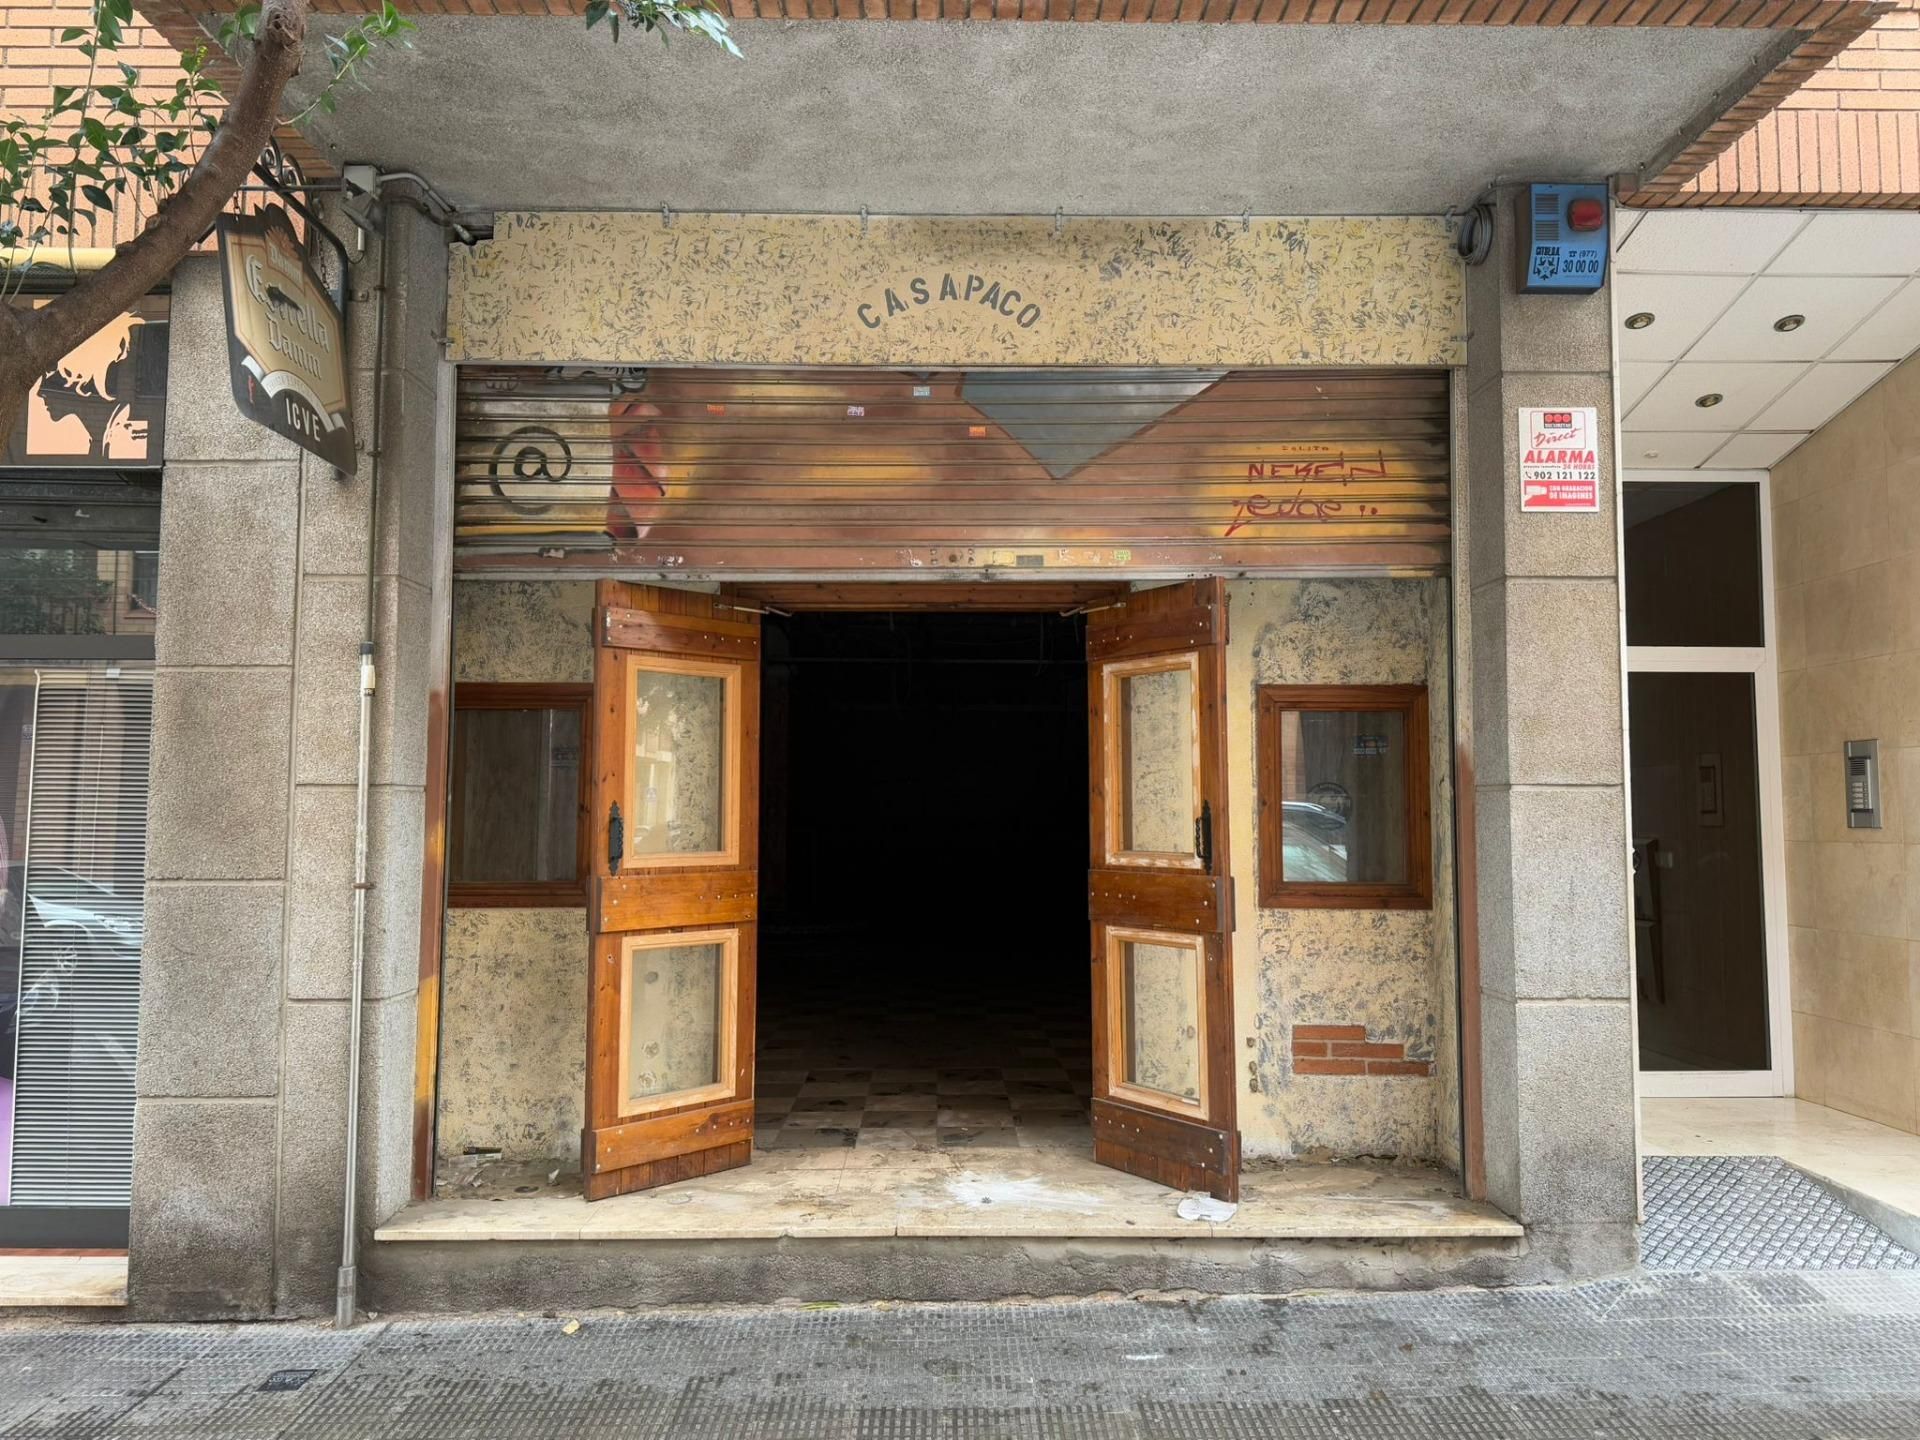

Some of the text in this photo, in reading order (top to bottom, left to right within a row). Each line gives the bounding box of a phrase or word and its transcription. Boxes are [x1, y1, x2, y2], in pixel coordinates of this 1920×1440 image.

[1579, 249, 1598, 258] (977)
[1562, 260, 1599, 273] 30 00 00
[265, 312, 322, 380] Damm
[286, 398, 322, 443] ICVE
[1523, 450, 1595, 463] ALARMA
[1534, 471, 1596, 480] 902 121 122
